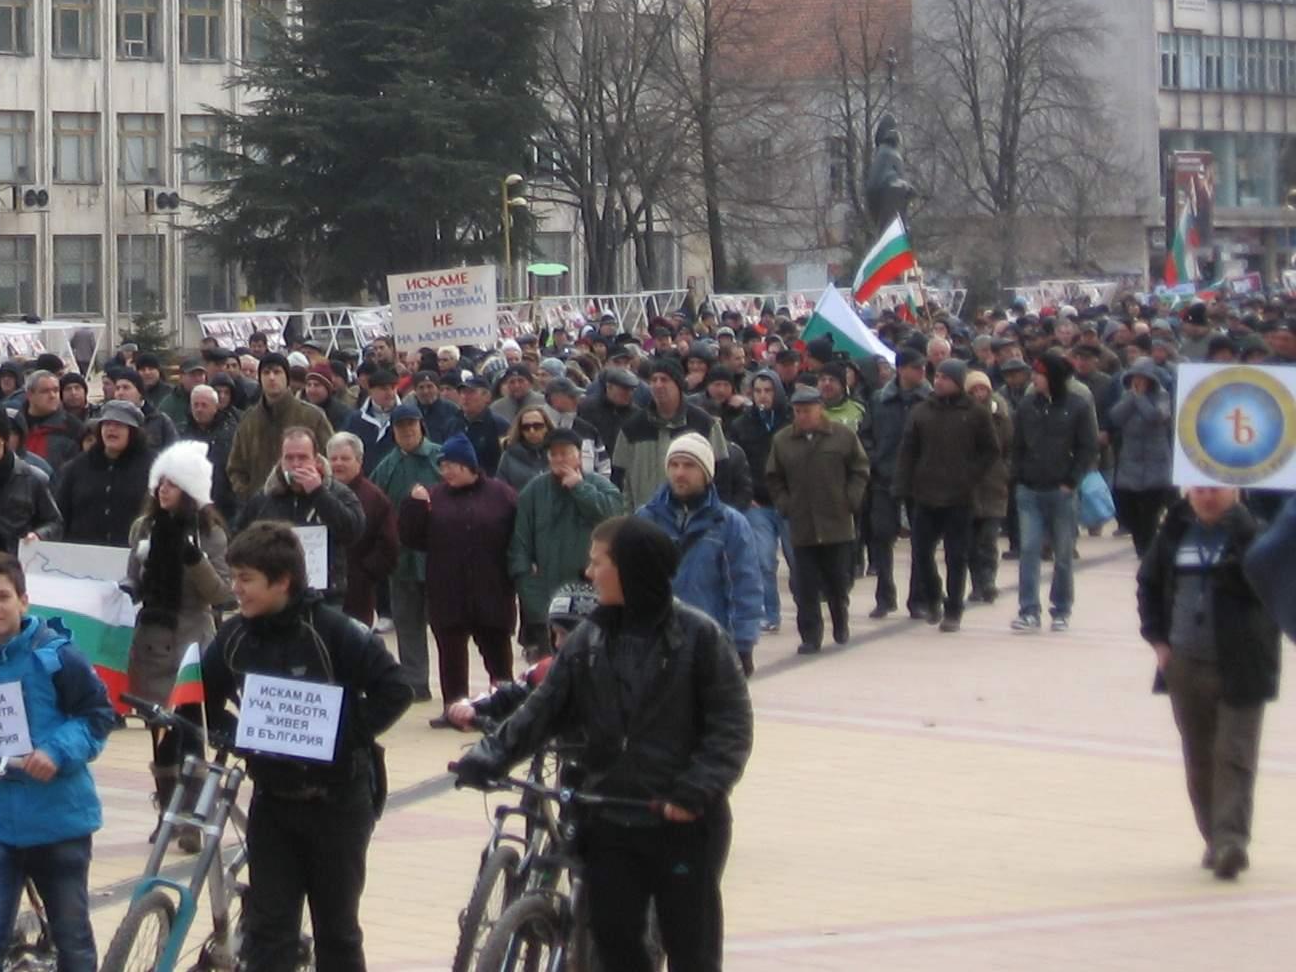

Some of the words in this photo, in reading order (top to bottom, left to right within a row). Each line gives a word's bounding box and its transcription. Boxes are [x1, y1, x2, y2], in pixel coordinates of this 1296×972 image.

[406, 272, 468, 290] ИСКАМЕ
[432, 313, 454, 327] НЕ
[397, 334, 413, 344] НА
[260, 686, 302, 700] ИСКАМ
[305, 692, 322, 704] ДА
[278, 702, 331, 720] РАБОТЯ,
[265, 715, 309, 730] ЖИВЕЯ
[246, 726, 255, 737] В
[258, 728, 324, 746] БЪЛГАРИЯ
